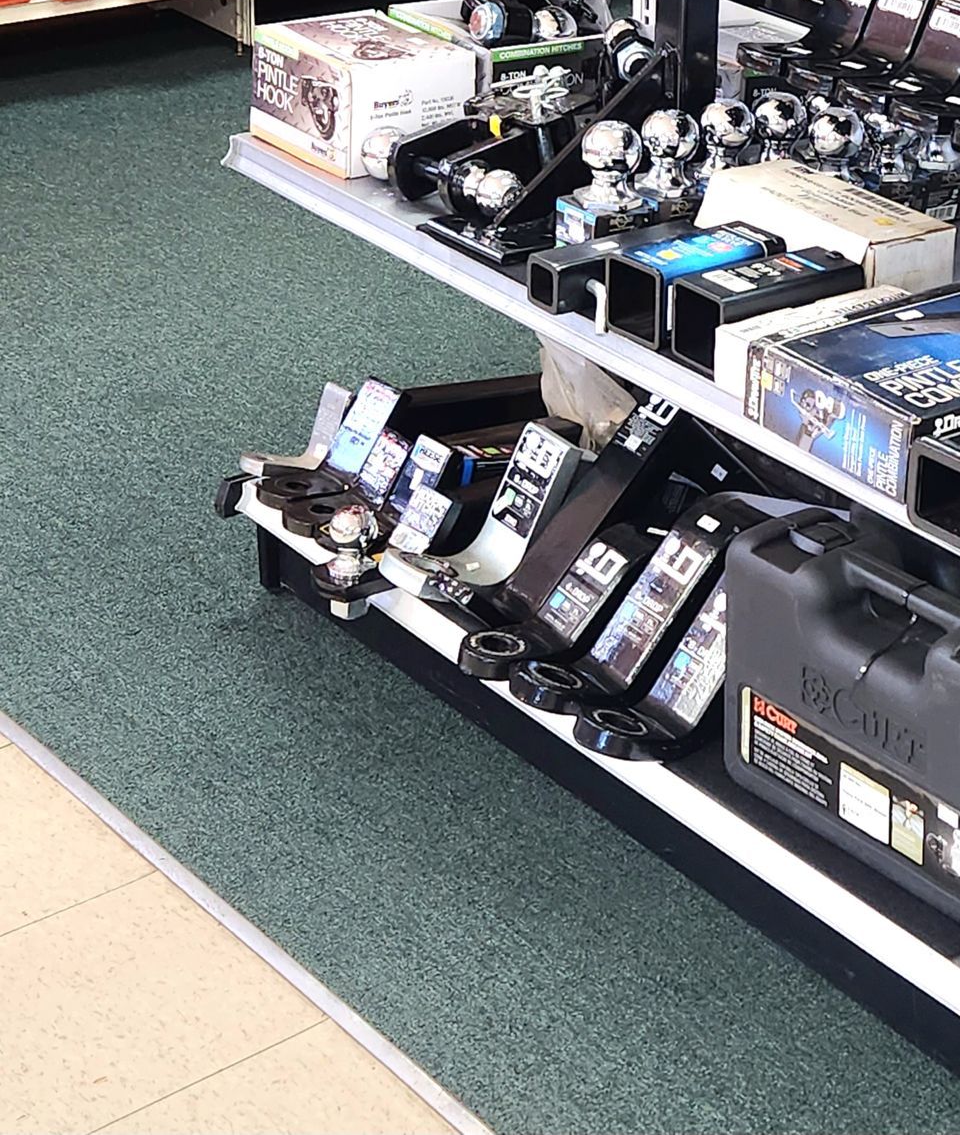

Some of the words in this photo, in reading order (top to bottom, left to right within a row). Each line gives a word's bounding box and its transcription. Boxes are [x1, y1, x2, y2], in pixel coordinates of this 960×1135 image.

[500, 47, 550, 60] COMBINATION
[258, 60, 299, 96] PINTLE
[500, 70, 526, 81] 8-TON
[256, 80, 295, 114] HOOK
[864, 354, 940, 382] ONE-PIECE
[886, 420, 904, 497] COMBINATION
[766, 704, 798, 734] CURT
